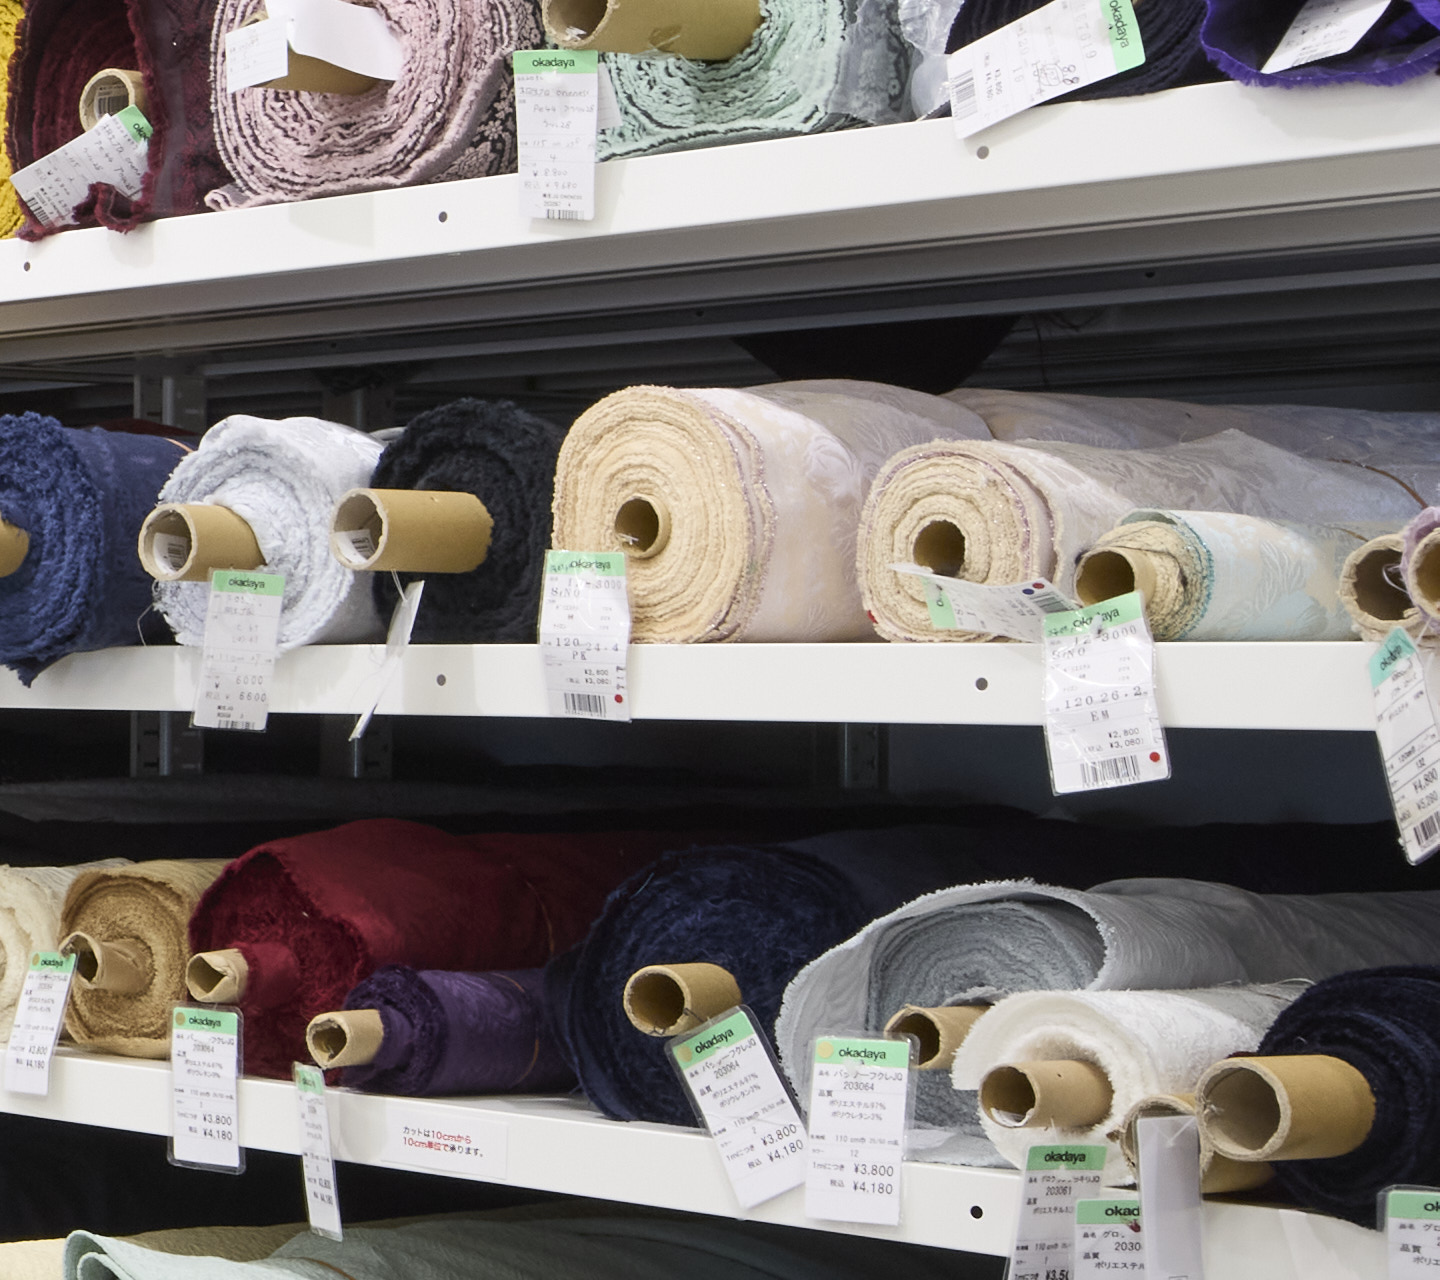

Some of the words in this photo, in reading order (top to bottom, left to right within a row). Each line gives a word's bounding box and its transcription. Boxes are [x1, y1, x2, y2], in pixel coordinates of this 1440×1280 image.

[1109, 0, 1129, 48] okadaya
[532, 58, 575, 68] okadaya
[228, 578, 265, 590] okadaya
[188, 1016, 222, 1028] okadaya
[695, 1028, 734, 1054] okadaya
[838, 1047, 886, 1060] okadaya
[843, 1081, 875, 1091] 203064
[403, 1126, 472, 1144] カットは10cmから
[1044, 1151, 1086, 1163] okadaya
[1105, 1205, 1140, 1217] okad
[1400, 1244, 1422, 1254] 品質
[1083, 1252, 1100, 1260] 品質
